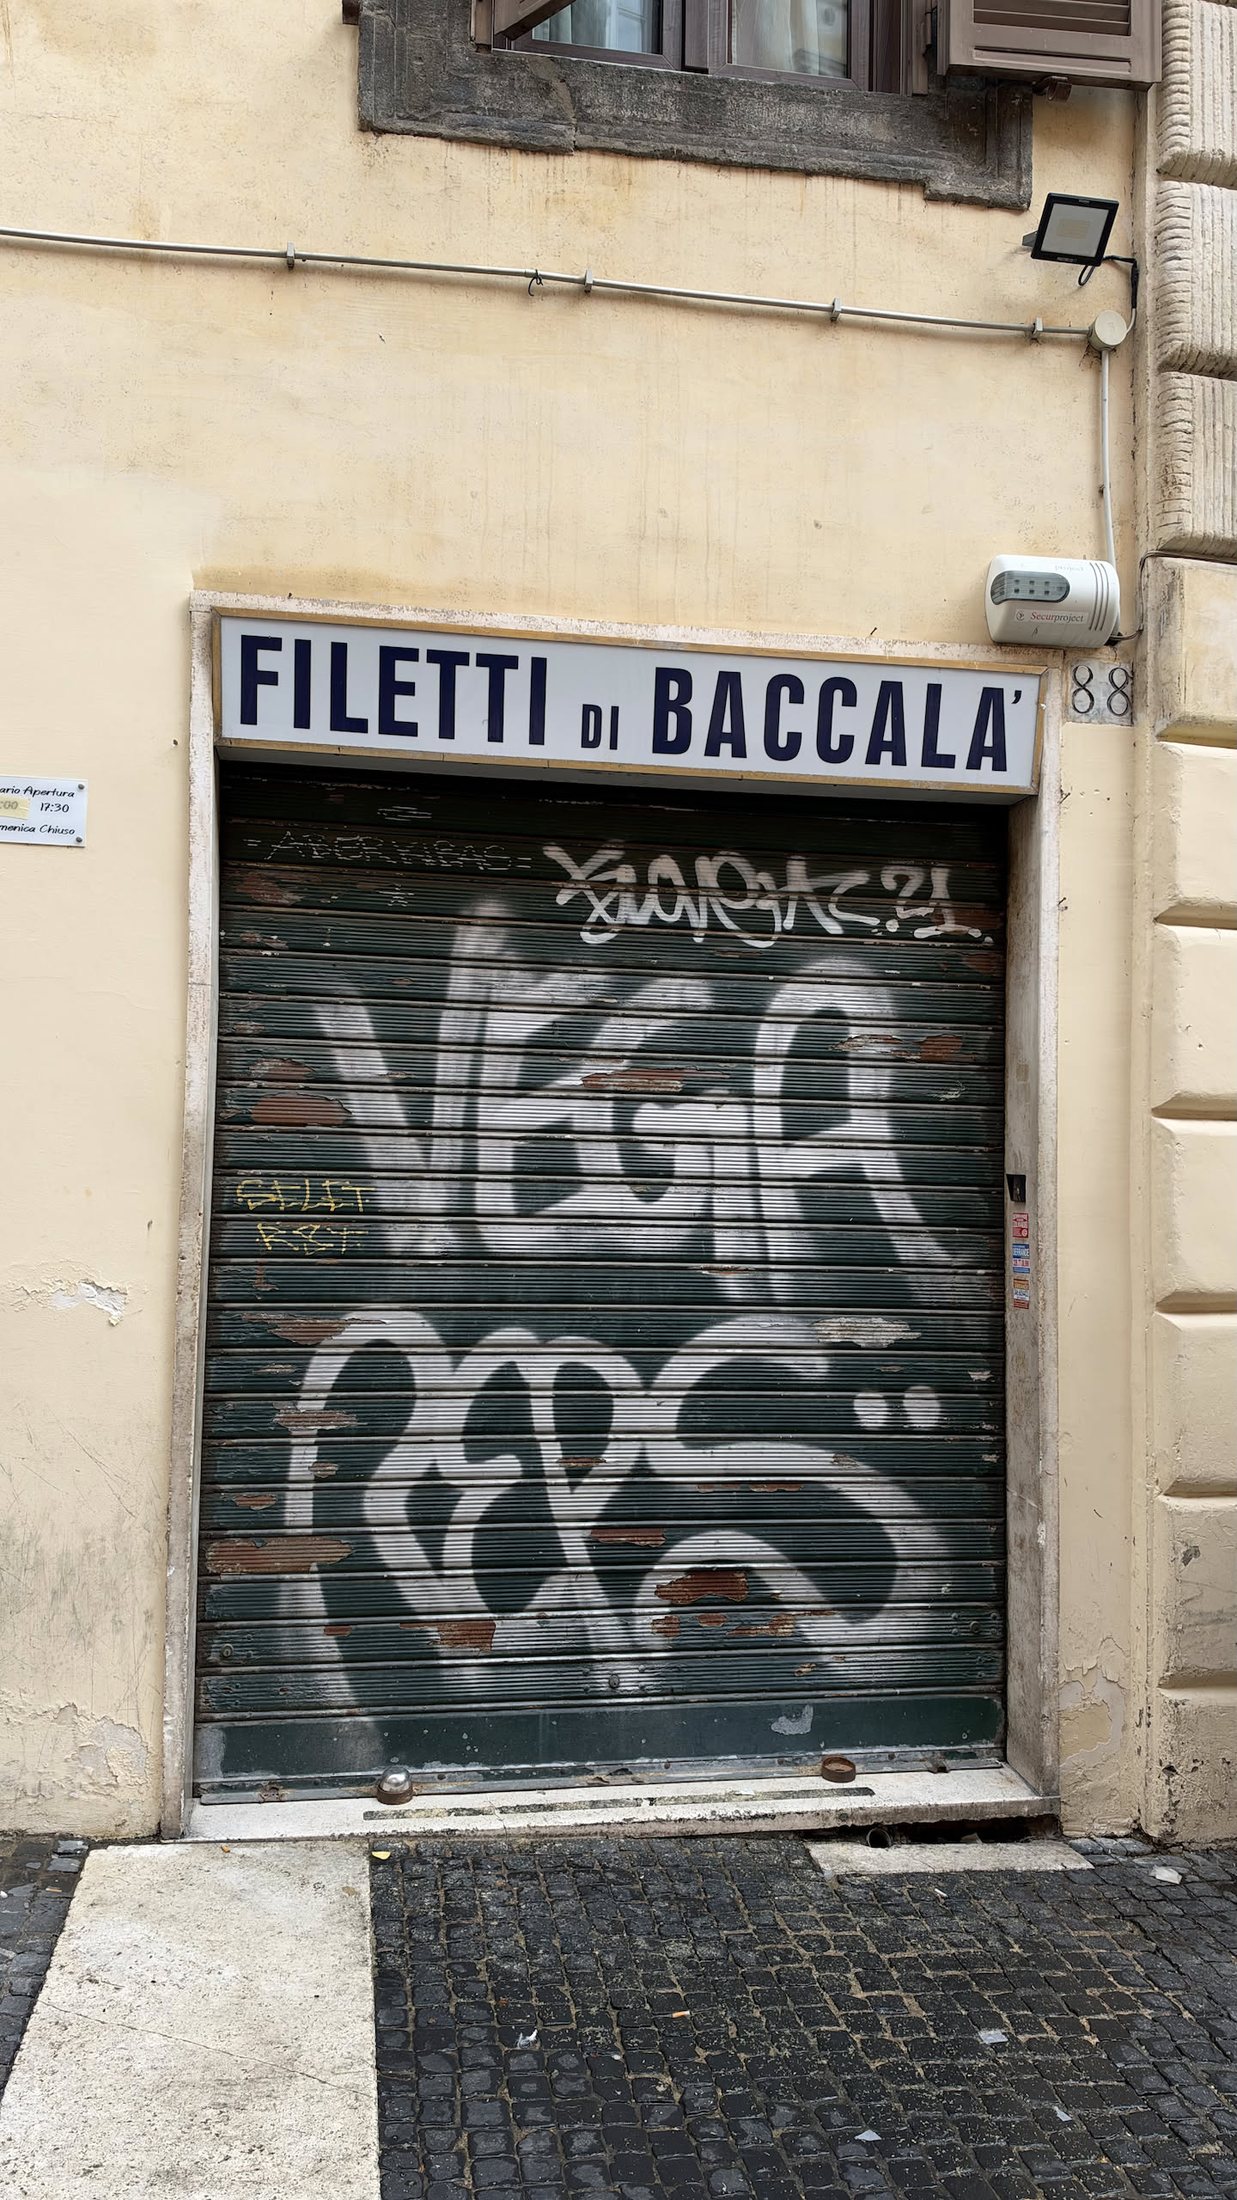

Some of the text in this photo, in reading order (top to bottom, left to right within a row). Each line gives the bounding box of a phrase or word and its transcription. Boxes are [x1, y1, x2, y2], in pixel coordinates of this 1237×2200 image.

[1030, 611, 1084, 624] Securproject
[1071, 664, 1133, 717] 88
[240, 634, 1022, 772] FILETTI DI BACCALA'
[23, 785, 75, 798] Apertura
[40, 802, 70, 813] 17:30
[39, 824, 76, 835] Chiuso
